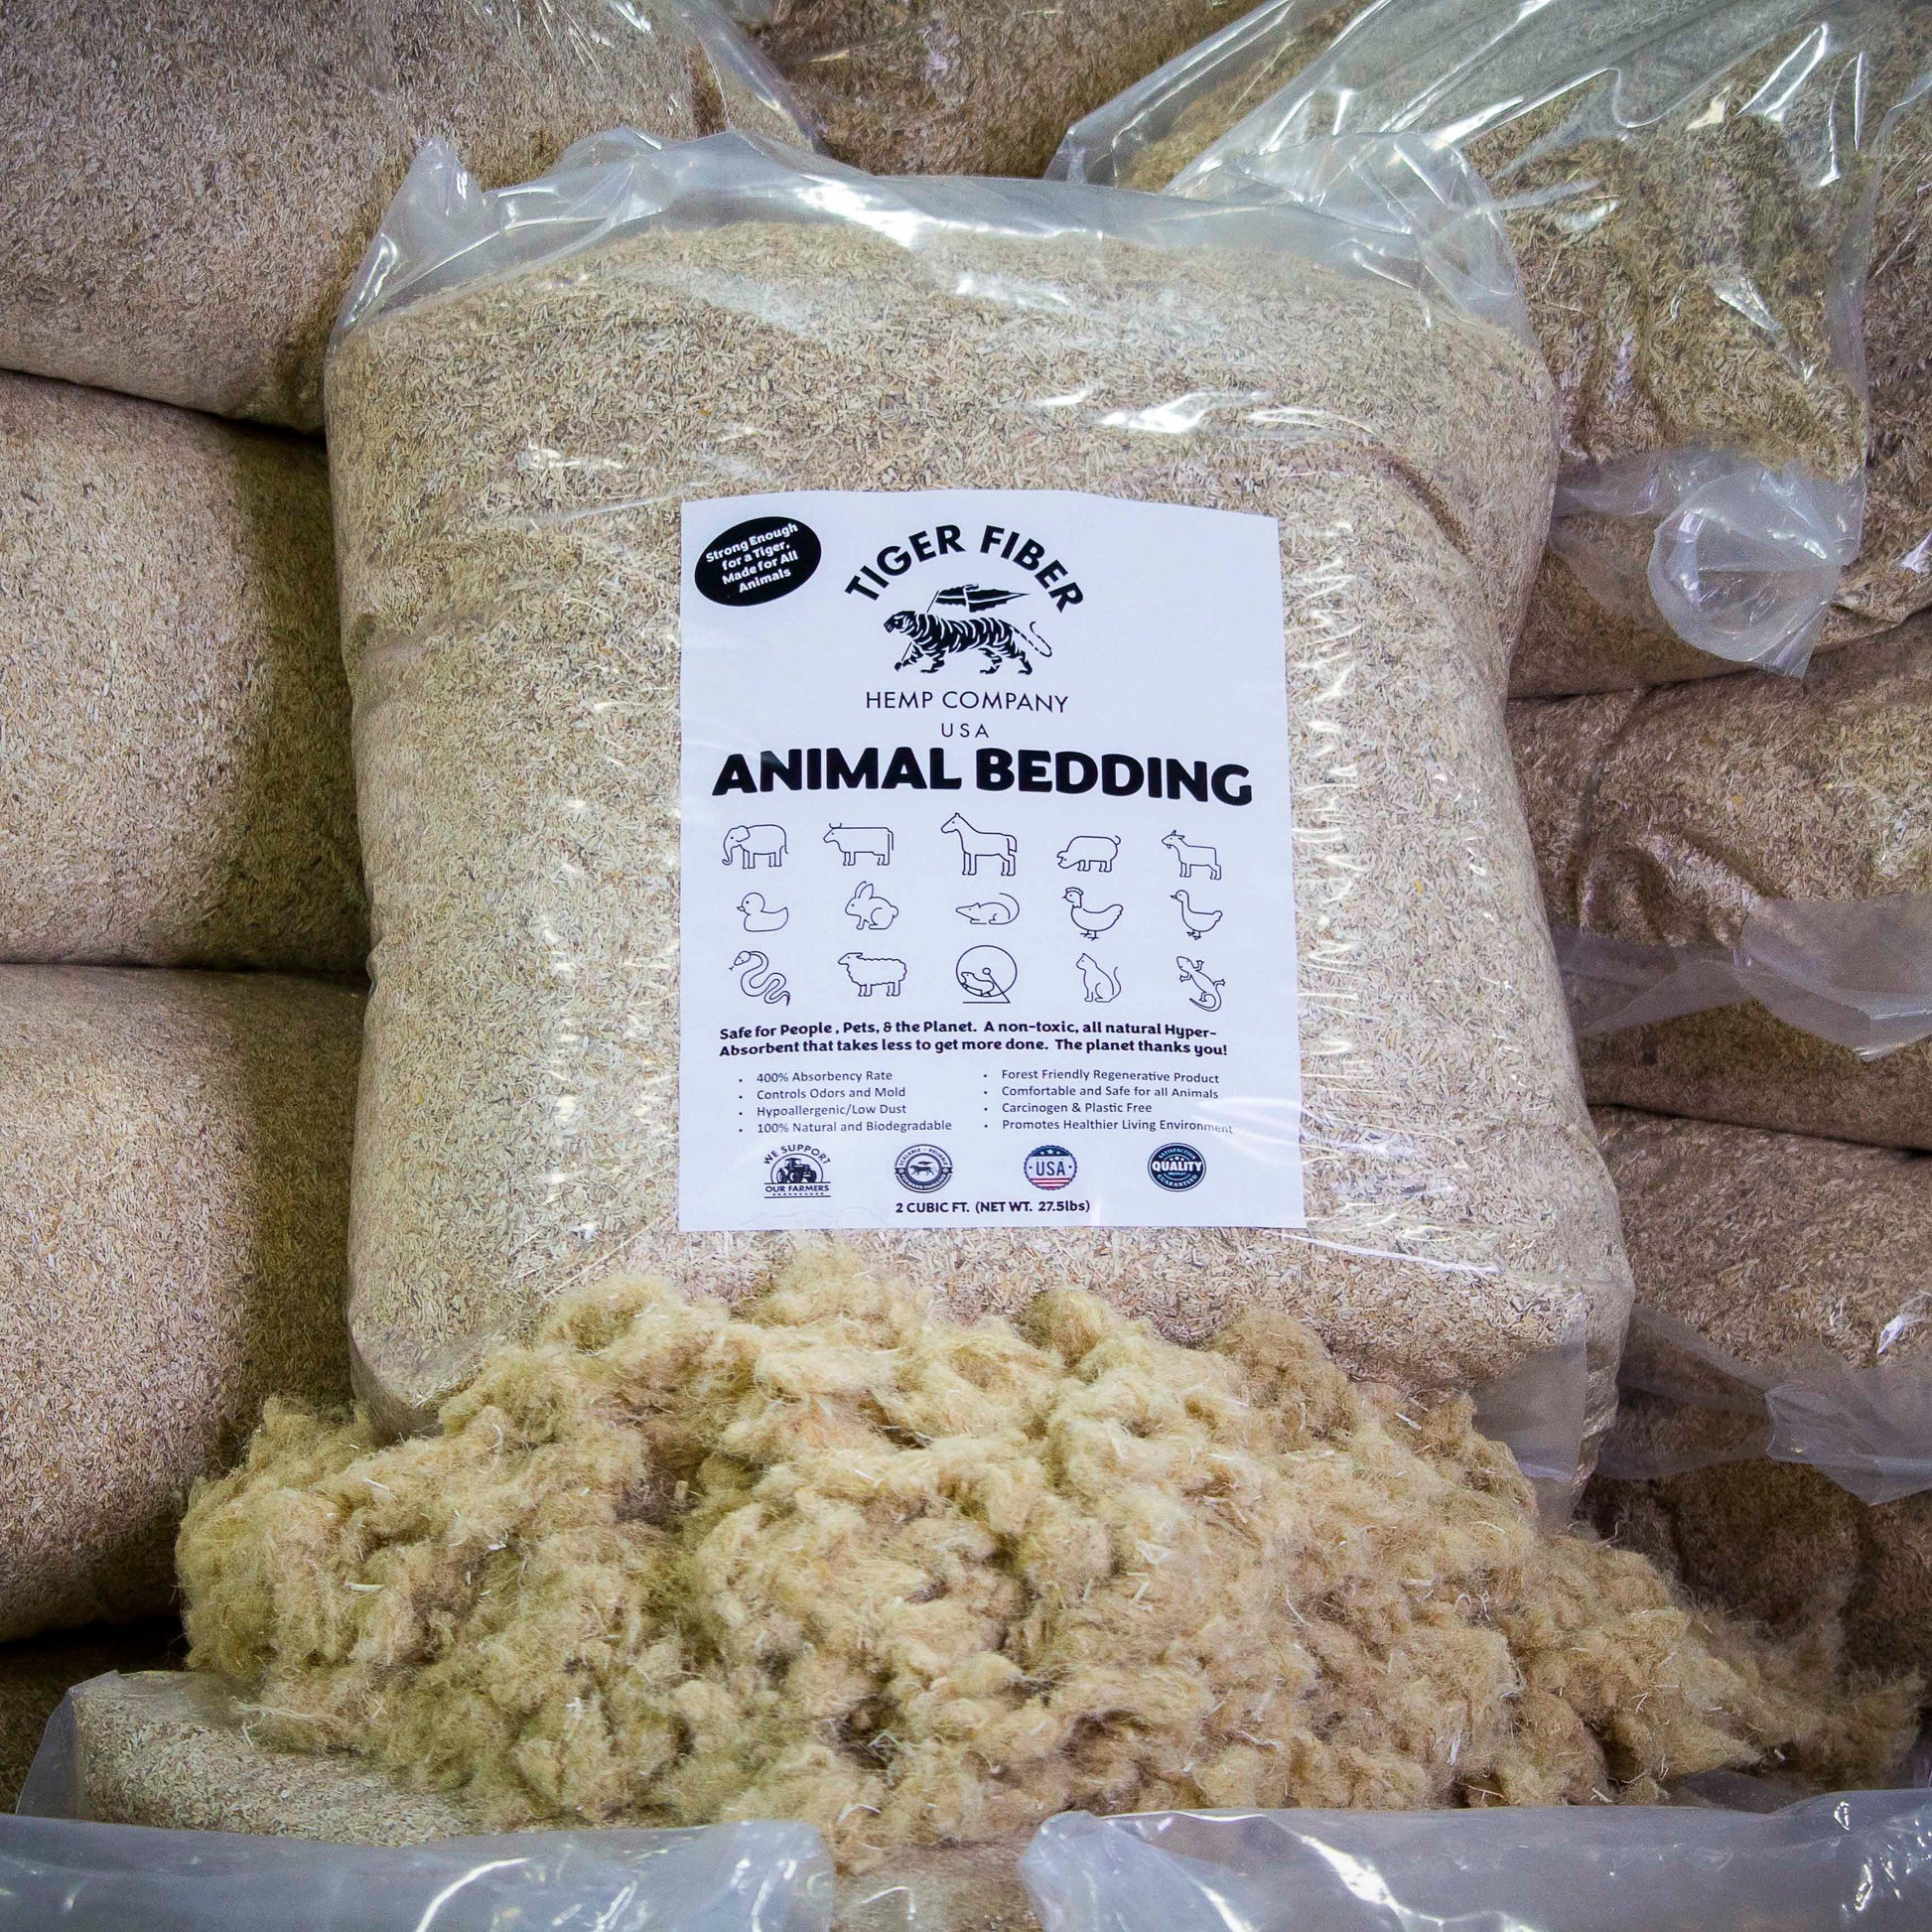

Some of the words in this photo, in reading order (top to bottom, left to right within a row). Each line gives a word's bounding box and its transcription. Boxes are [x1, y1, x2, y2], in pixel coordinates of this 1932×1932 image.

[706, 540, 750, 563] Strong
[749, 522, 798, 546] Enough
[722, 557, 742, 571] for
[722, 565, 758, 585] Made
[758, 558, 778, 572] for
[779, 550, 799, 564] All
[844, 523, 966, 601] TIGER
[980, 524, 1084, 613] FIBER
[739, 568, 791, 593] Animals
[867, 691, 933, 709] HEMP
[942, 691, 1068, 713] COMPANY
[941, 723, 989, 738] USA
[712, 747, 962, 796] ANIMAL
[976, 748, 1252, 806] BEDDING
[720, 1027, 753, 1039] Safe
[755, 1026, 777, 1037] for
[843, 1022, 880, 1034] Pets,
[883, 1022, 893, 1033] &
[896, 1021, 920, 1033] the
[923, 1021, 977, 1033] Planet.
[984, 1021, 995, 1032] A
[998, 1021, 1079, 1034] non-toxic,
[1082, 1021, 1102, 1033] all
[1105, 1023, 1162, 1035] natural
[1165, 1024, 1216, 1039] Hyper-
[719, 1041, 799, 1056] Absorbent
[803, 1039, 834, 1051] that
[837, 1038, 879, 1051] takes
[882, 1038, 912, 1050] less
[915, 1039, 931, 1050] to
[934, 1039, 958, 1053] get
[962, 1040, 1002, 1049] more
[1005, 1037, 1048, 1049] done.
[1054, 1038, 1082, 1050] The
[1086, 1038, 1135, 1054] planet
[1138, 1039, 1190, 1053] thanks
[1194, 1044, 1227, 1057] you!
[757, 1072, 788, 1083] 400%
[792, 1071, 863, 1083] Absorbency
[866, 1070, 893, 1080] Rate
[1002, 1069, 1038, 1079] Forest
[1041, 1069, 1090, 1081] Friendly
[1093, 1069, 1170, 1081] Regenerative
[1173, 1072, 1219, 1083] Product
[757, 1088, 806, 1100] Controls
[810, 1088, 846, 1098] Odors
[849, 1087, 871, 1098] and
[875, 1087, 905, 1097] Mold
[1002, 1085, 1076, 1096] Comfortable
[1079, 1085, 1102, 1096] and
[1105, 1085, 1131, 1096] Safe
[1134, 1086, 1151, 1096] for
[1154, 1087, 1168, 1096] all
[1172, 1088, 1218, 1099] Animals
[758, 1104, 877, 1118] Hypoallergenic/Low
[880, 1104, 906, 1114] Dust
[1002, 1102, 1068, 1115] Carcinogen
[1071, 1102, 1081, 1113] &
[1085, 1102, 1123, 1113] Plastic
[1127, 1102, 1152, 1113] Free
[758, 1123, 789, 1133] 100%
[793, 1122, 836, 1132] Natural
[840, 1121, 863, 1132] and
[867, 1120, 952, 1133] Biodegradable
[1003, 1120, 1060, 1130] Promotes
[1063, 1119, 1118, 1130] Healthier
[1122, 1119, 1156, 1132] Living
[1160, 1120, 1233, 1134] Environment
[763, 1150, 779, 1165] WE
[780, 1144, 831, 1165] SUPPORT
[1035, 1161, 1065, 1176] USA
[1152, 1161, 1202, 1172] QUALITY
[1157, 1173, 1197, 1187] GUARANTEED
[896, 1202, 903, 1213] 2
[906, 1202, 949, 1213] CUBIC
[952, 1202, 970, 1212] FT.
[975, 1201, 1006, 1214] (NET
[1009, 1201, 1033, 1212] WT.
[1038, 1200, 1090, 1212] 27.5lbs)
